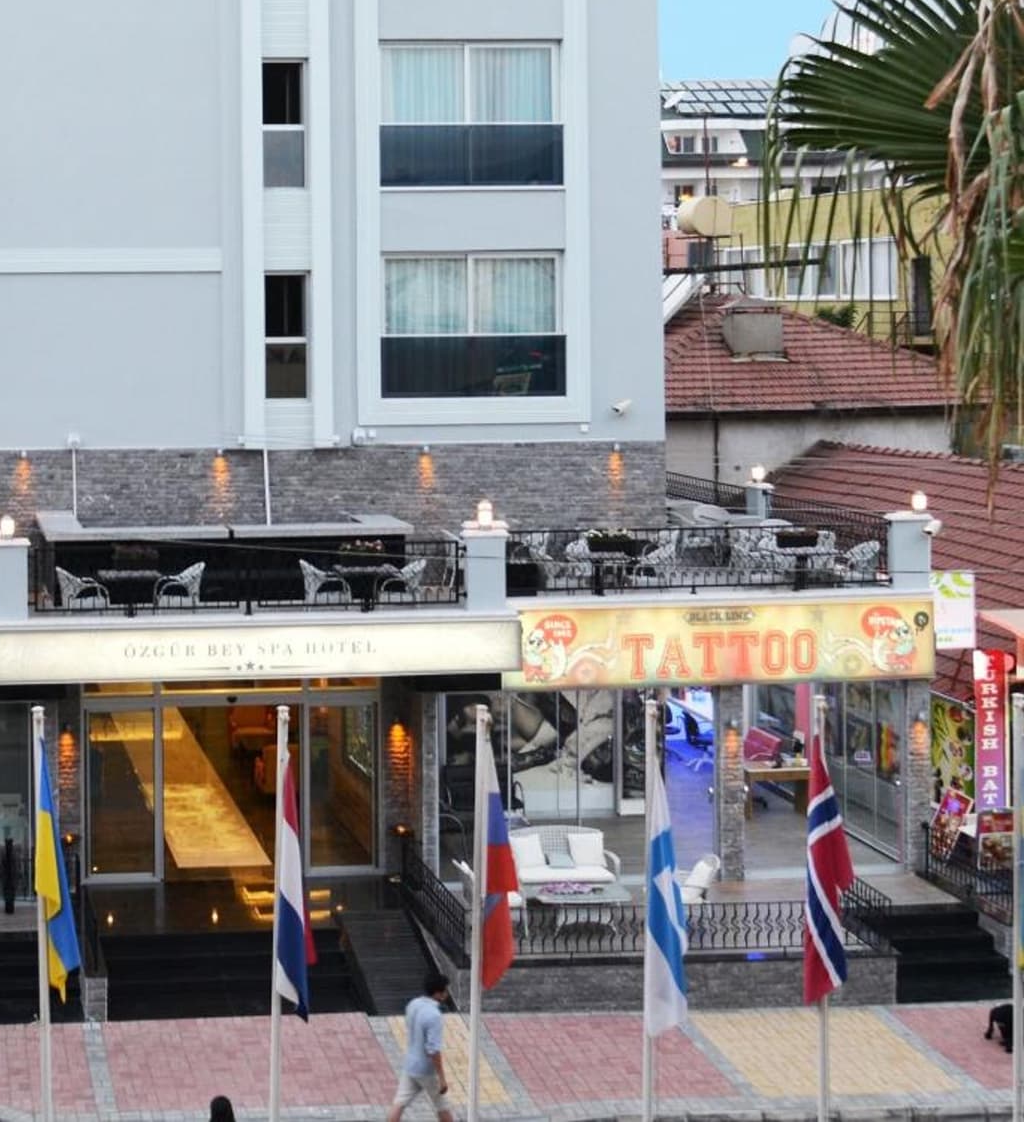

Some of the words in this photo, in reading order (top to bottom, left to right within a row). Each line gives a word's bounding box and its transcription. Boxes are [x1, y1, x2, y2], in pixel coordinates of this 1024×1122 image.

[123, 641, 196, 658] ÖZGÜR
[207, 642, 247, 657] BEY
[257, 642, 294, 656] SPA
[305, 640, 377, 655] HOTEL
[622, 629, 818, 680] TATTOO
